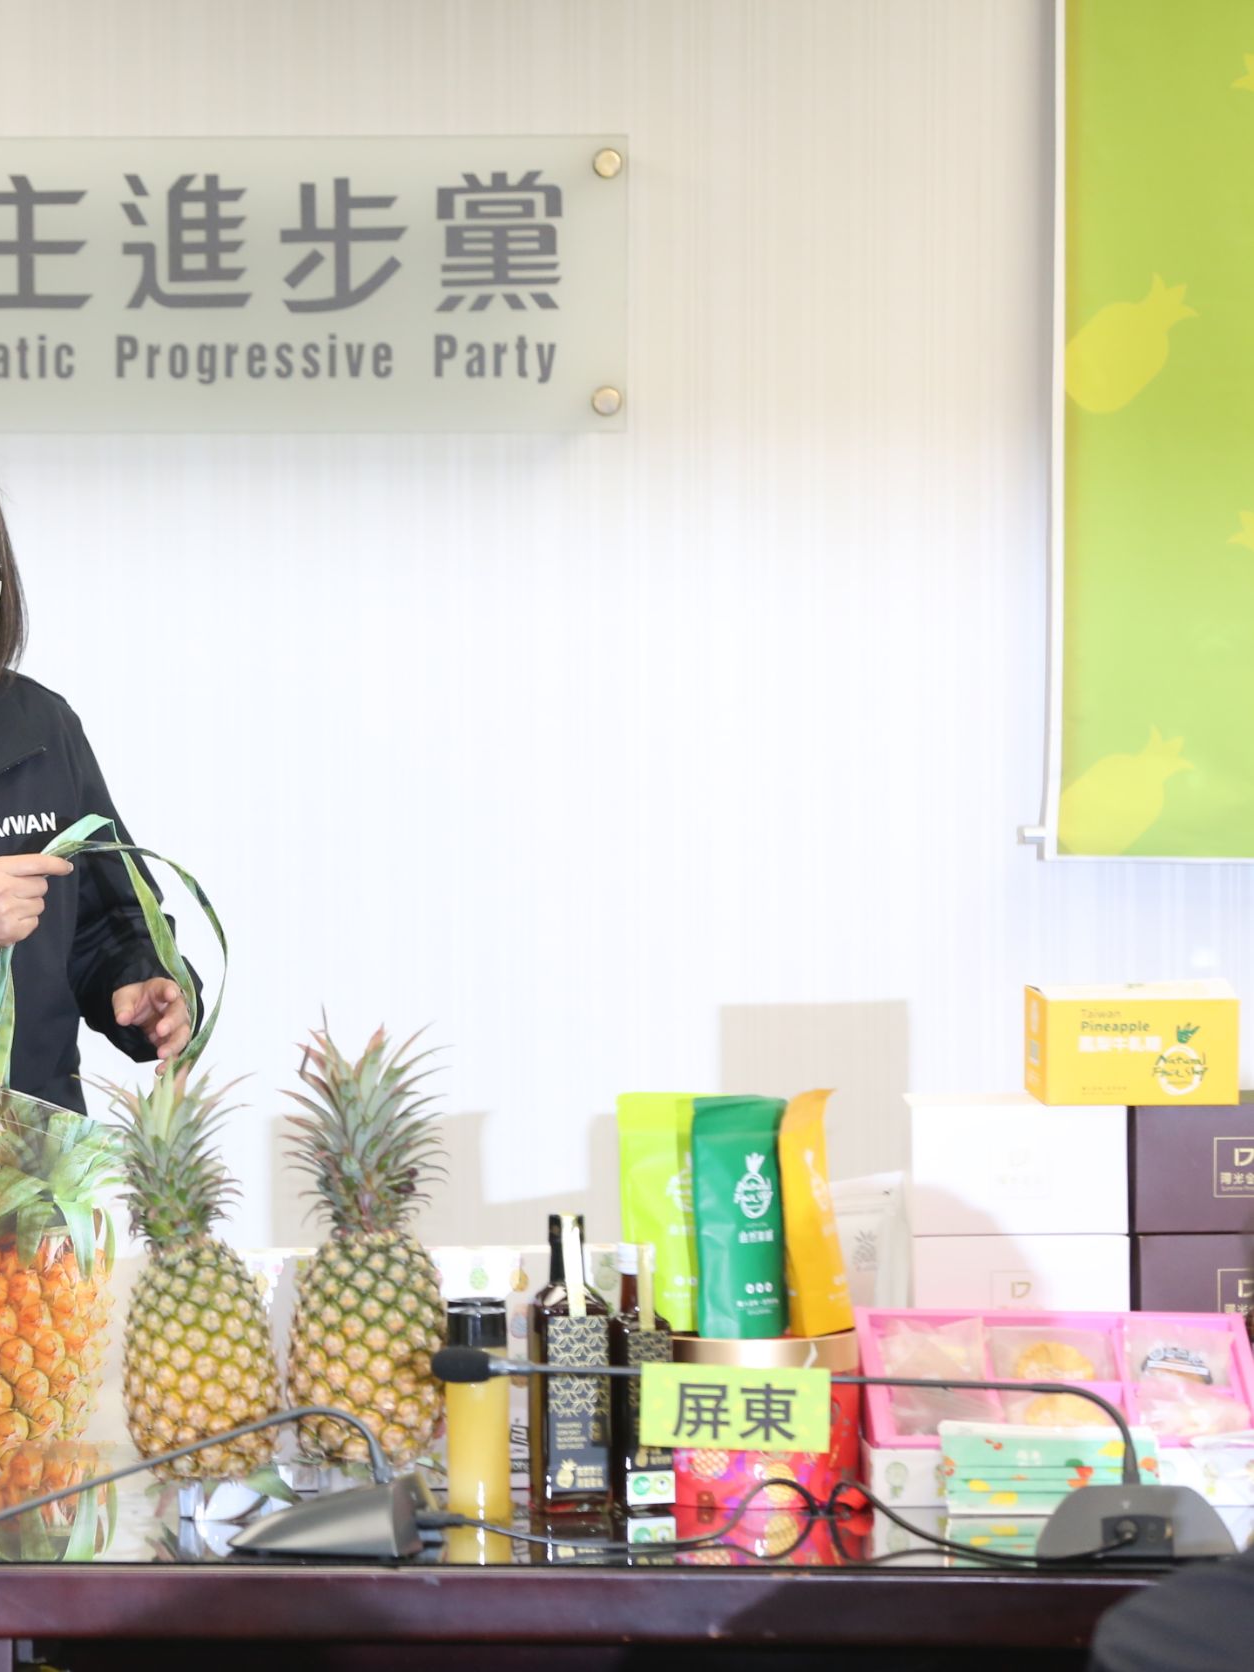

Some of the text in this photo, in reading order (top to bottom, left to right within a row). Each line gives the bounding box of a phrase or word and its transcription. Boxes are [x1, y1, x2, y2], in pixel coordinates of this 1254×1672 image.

[114, 332, 395, 384] Progressive
[433, 332, 558, 384] Party
[1080, 1020, 1151, 1033] Pineapple
[1081, 1008, 1122, 1019] Taiwan
[672, 1382, 797, 1442] 屏東
